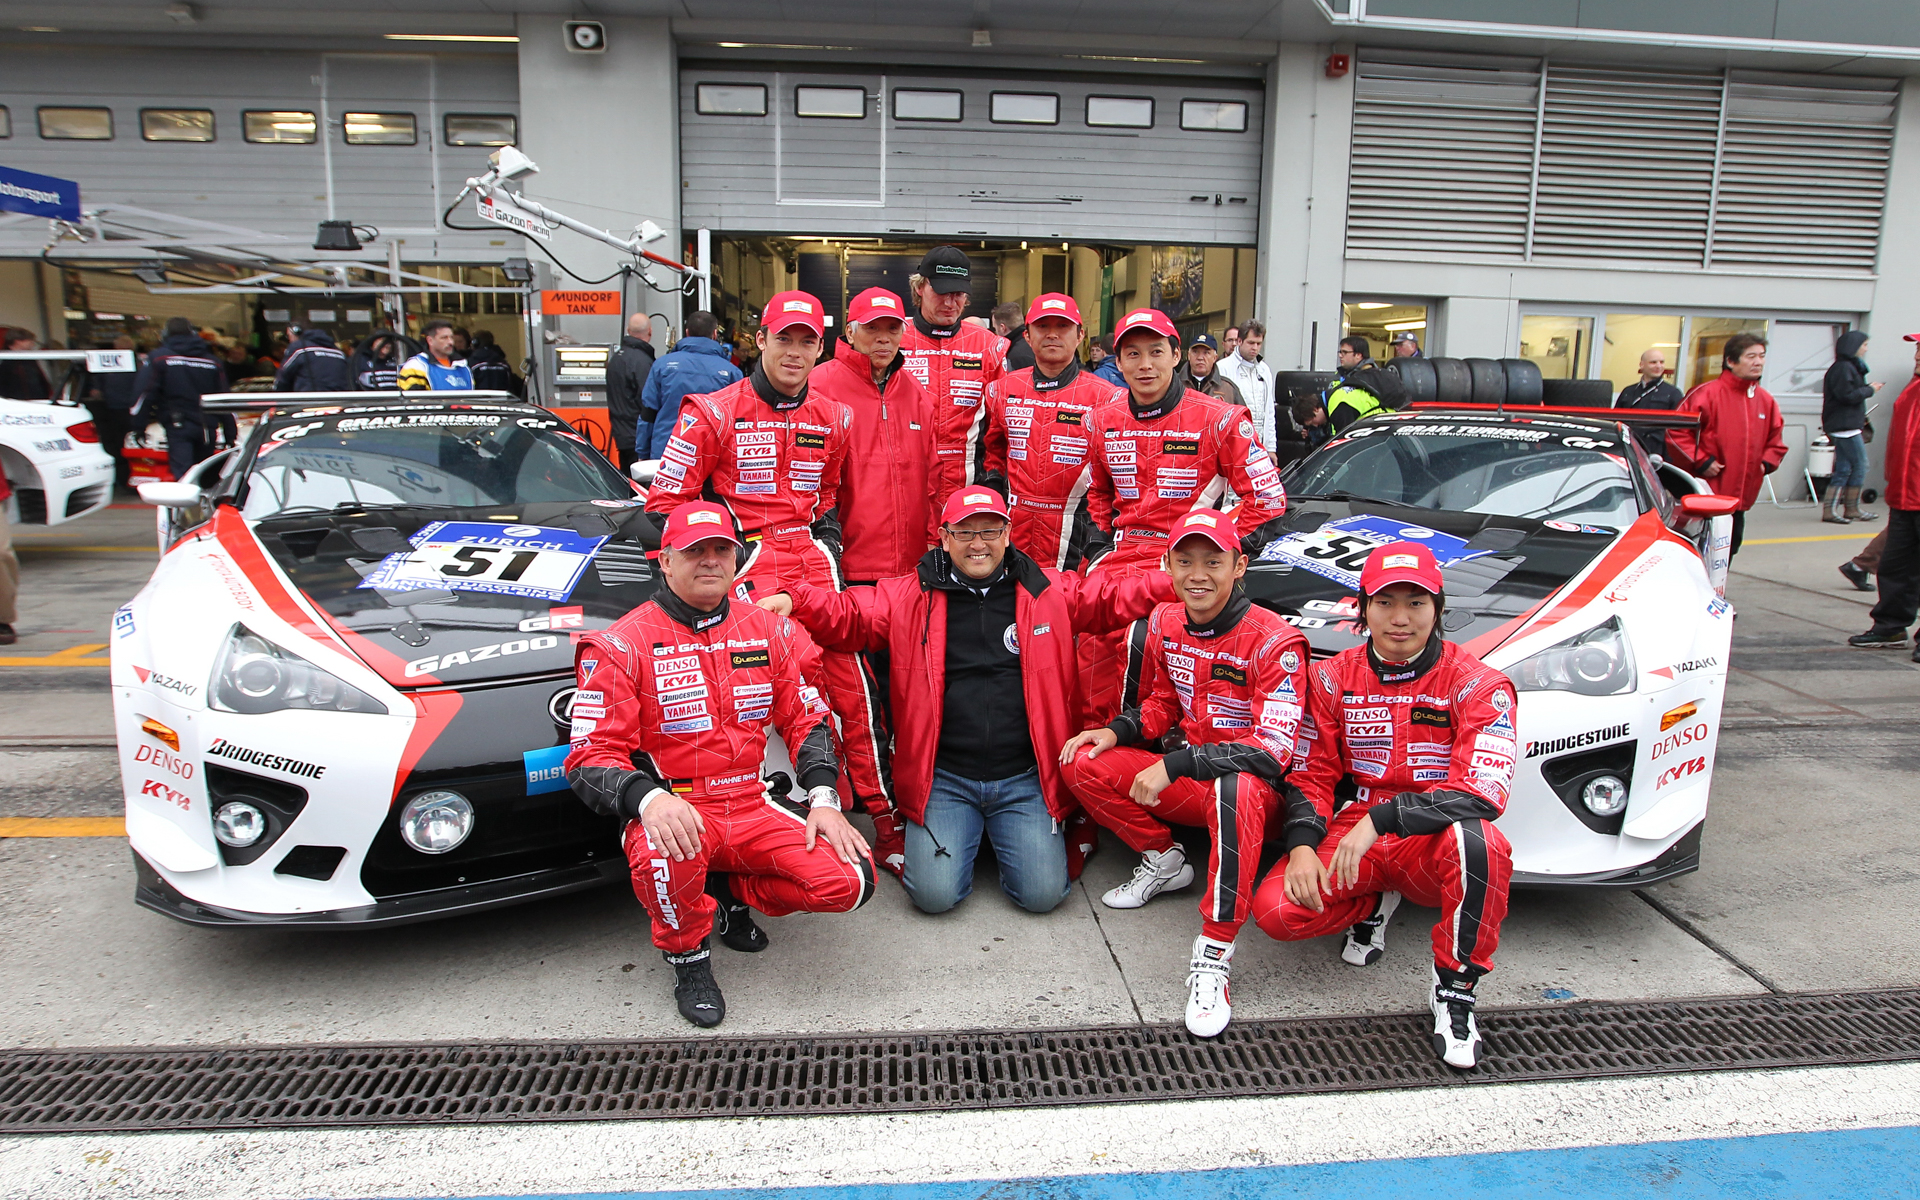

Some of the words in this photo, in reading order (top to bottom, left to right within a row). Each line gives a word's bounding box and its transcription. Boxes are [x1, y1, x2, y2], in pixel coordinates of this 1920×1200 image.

[480, 204, 493, 218] GR
[495, 209, 526, 229] GAZOO
[526, 219, 550, 239] Racing
[551, 292, 613, 302] MUNDORF
[567, 304, 596, 313] TANK
[951, 350, 983, 359] Racing
[1023, 398, 1056, 407] GAZOO
[1006, 408, 1032, 416] DENSO
[338, 416, 402, 429] GRAN
[407, 415, 501, 423] TURISMO
[735, 421, 754, 430] GR
[756, 421, 797, 430] GAZOO
[798, 422, 832, 434] Racing
[739, 434, 773, 443] DENSO
[1105, 430, 1120, 438] GR
[1122, 430, 1161, 438] GAZOO
[1163, 430, 1201, 439] Racing
[1397, 426, 1456, 434] GRAN
[1459, 425, 1551, 439] TURISMO
[674, 440, 695, 452] YAZAKI
[743, 447, 771, 456] KYB
[1106, 442, 1134, 450] DENSO
[1109, 455, 1132, 463] KYB
[667, 466, 683, 477] MSIG
[742, 472, 771, 481] YAMAHA
[655, 476, 680, 491] NEXT
[794, 482, 818, 490] AISIN
[1254, 473, 1278, 489] TOM'S
[455, 535, 564, 551] ZURICH
[440, 546, 540, 582] 51
[519, 613, 582, 632] GR
[1034, 626, 1050, 636] GR
[653, 646, 675, 656] GR
[727, 639, 769, 648] Racing
[1181, 644, 1215, 659] GAZOO
[404, 635, 558, 679] GAZOO
[741, 655, 768, 663] LEXUS
[657, 658, 697, 673] DENSO
[1673, 656, 1718, 674] YAZAKI
[152, 672, 197, 696] YAZAKI
[663, 674, 698, 688] KYB
[661, 689, 705, 703] BRIDGESTONE
[1343, 695, 1365, 705] GR
[667, 703, 704, 718] YAMAHA
[740, 710, 767, 721] AISIN
[1265, 705, 1292, 717] charas
[1345, 709, 1389, 720] DENSO
[1262, 716, 1296, 733] TOM'S
[1349, 725, 1387, 734] KYB
[1484, 727, 1506, 737] SOUTH
[1479, 740, 1509, 754] charas
[1524, 722, 1630, 759] BRIDGESTONE
[1651, 723, 1708, 761] DENSO
[133, 744, 194, 780] DENSO
[206, 738, 327, 779] BRIDGESTONE
[1355, 751, 1387, 760] YAMAHA
[1475, 755, 1513, 773] TOM'S
[1655, 755, 1706, 791] KYB
[710, 777, 742, 787] A.HAHNE
[141, 779, 190, 811] KYB
[650, 858, 680, 930] Racing
